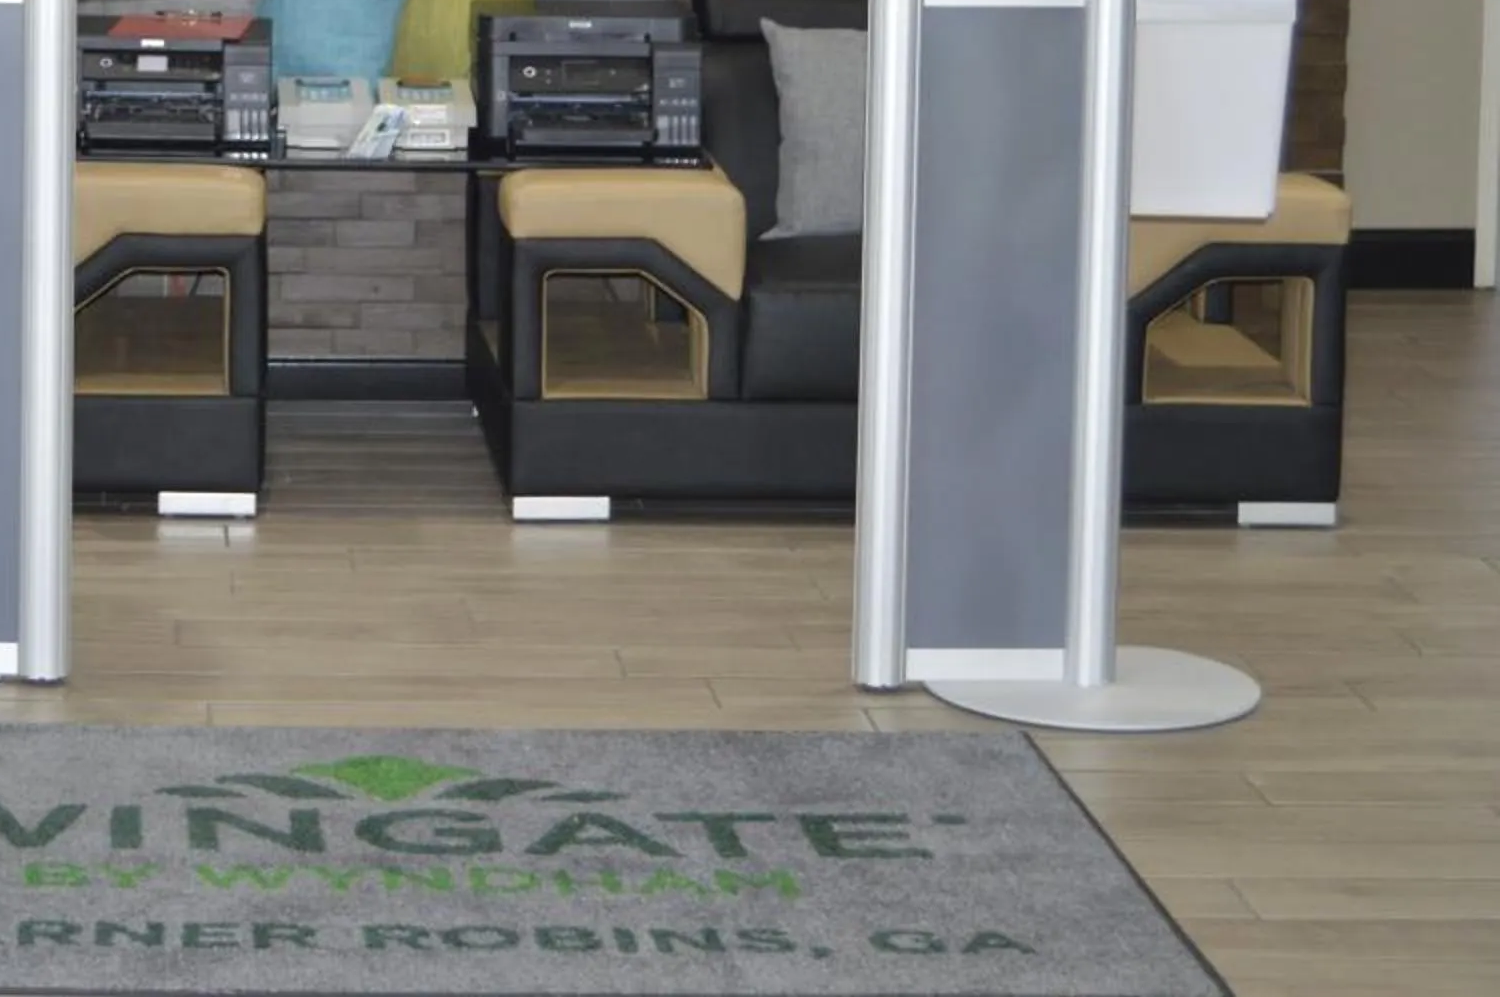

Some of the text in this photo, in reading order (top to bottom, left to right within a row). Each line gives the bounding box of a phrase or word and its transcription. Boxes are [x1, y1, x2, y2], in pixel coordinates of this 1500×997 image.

[23, 861, 800, 900] BY WYNDHAM
[364, 922, 834, 961] ROBINS,
[868, 927, 1039, 956] GA
